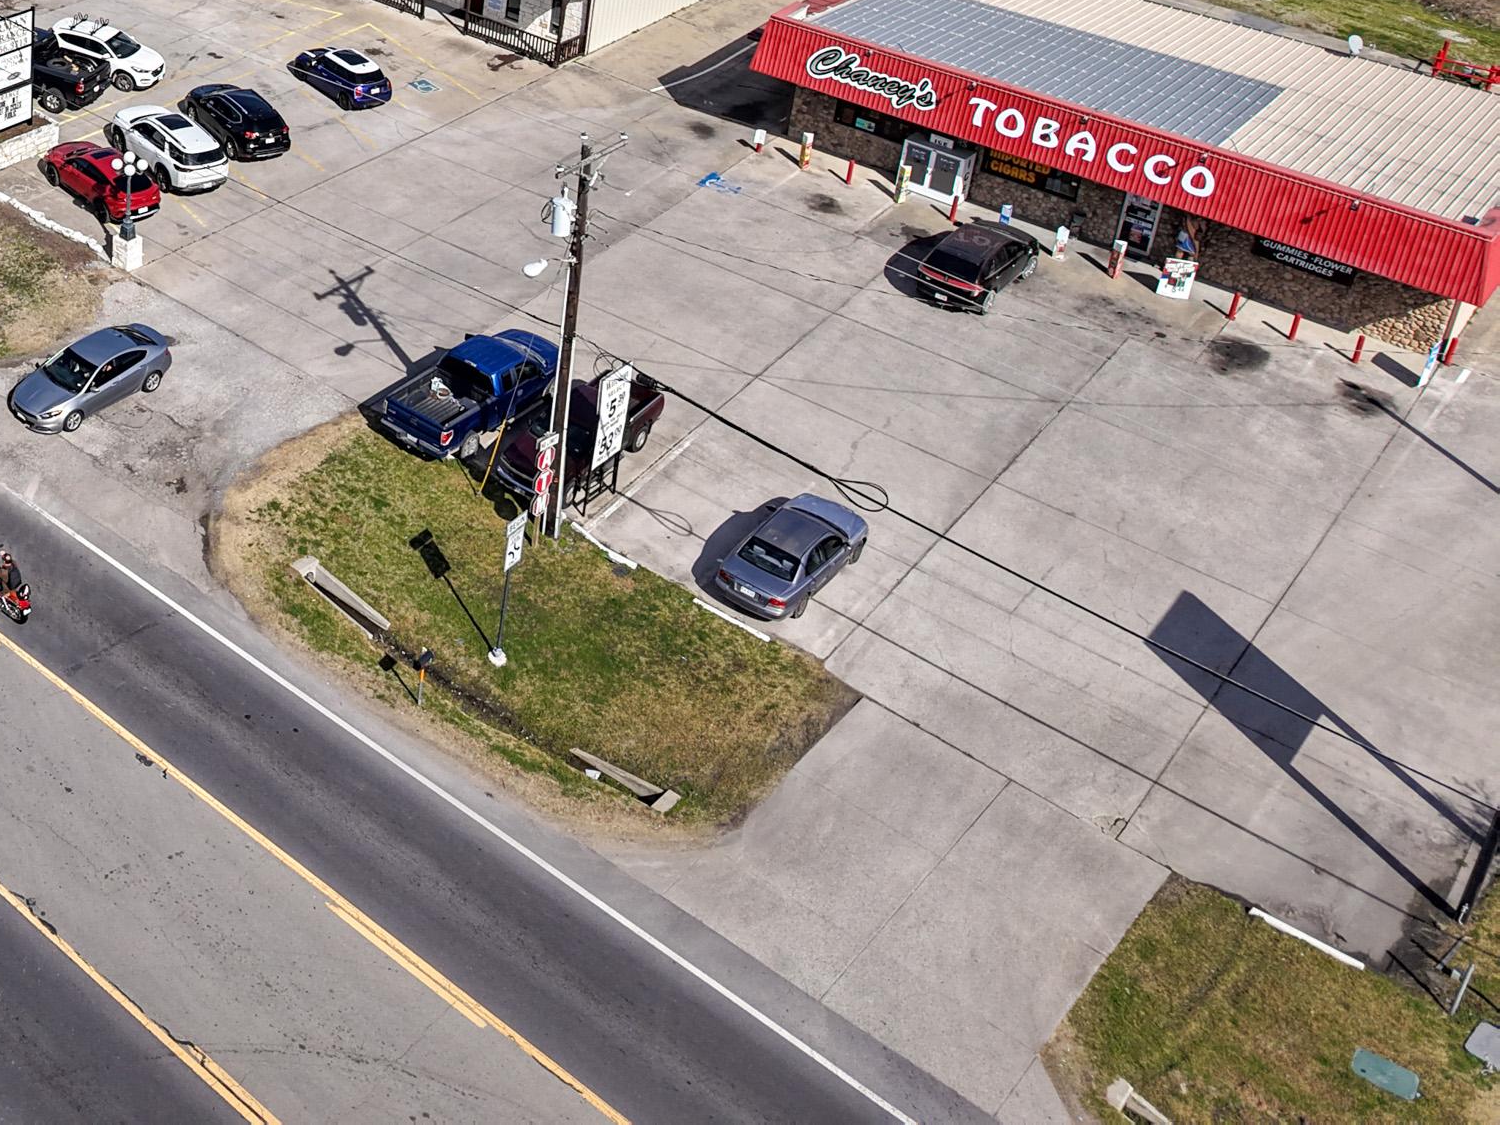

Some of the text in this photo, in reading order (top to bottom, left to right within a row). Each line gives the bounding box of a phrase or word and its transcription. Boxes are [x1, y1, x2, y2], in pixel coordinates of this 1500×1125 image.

[807, 46, 935, 110] Chaney's
[969, 97, 1216, 199] TOBACCO
[990, 160, 1036, 184] CIGARS
[1262, 239, 1353, 275] GUMMIES FLOWER
[1275, 252, 1334, 277] CARTRIDGES
[534, 448, 554, 515] ATM
